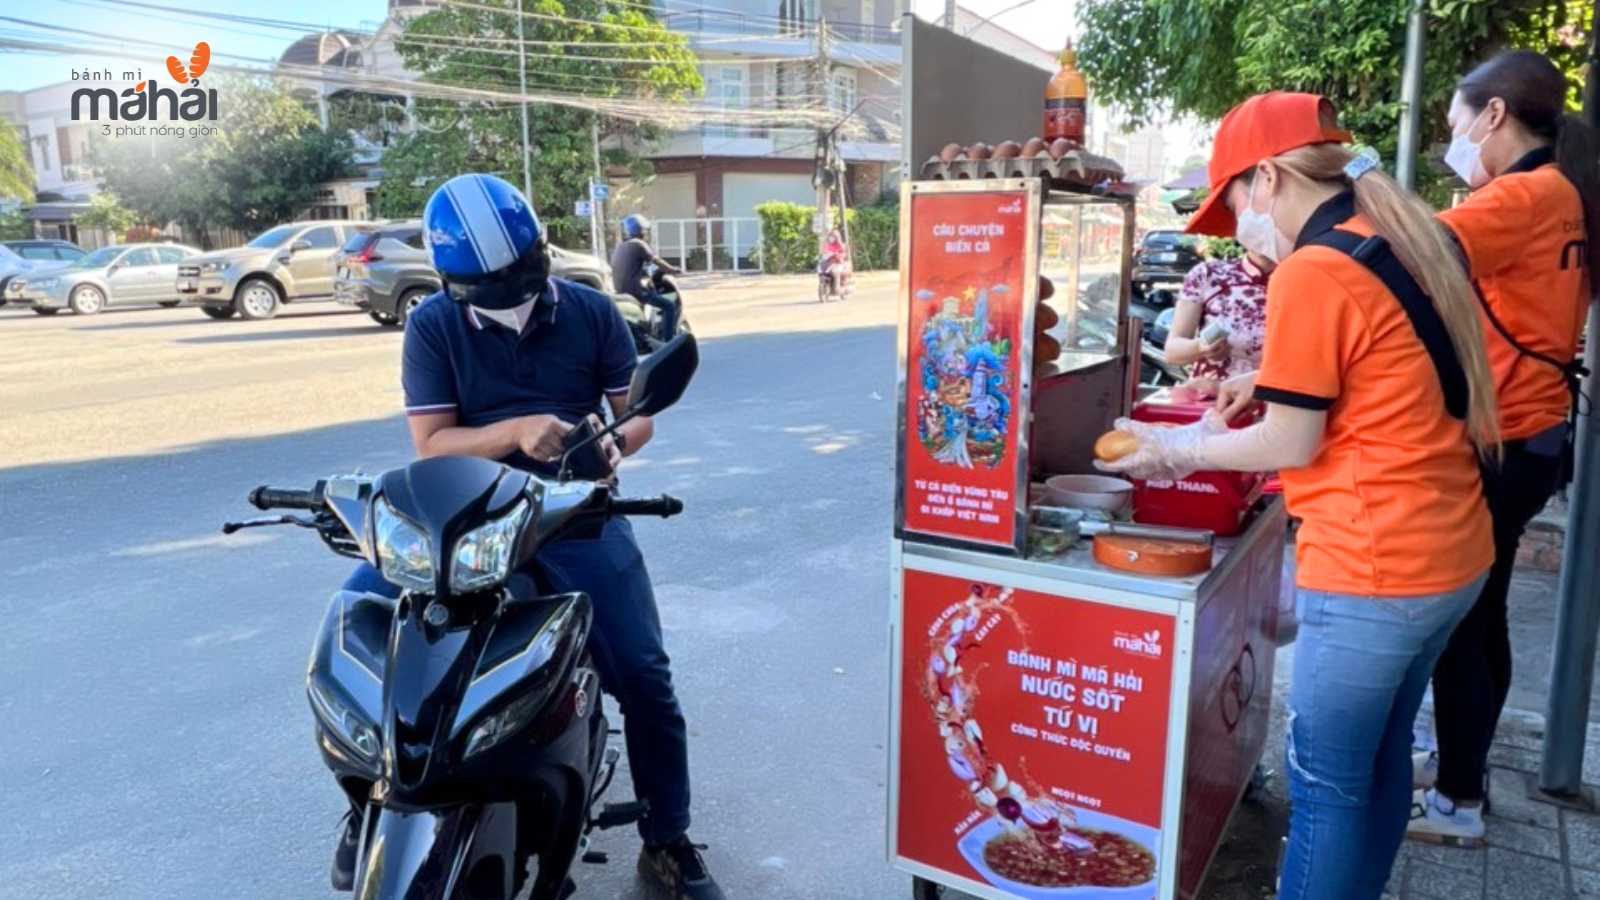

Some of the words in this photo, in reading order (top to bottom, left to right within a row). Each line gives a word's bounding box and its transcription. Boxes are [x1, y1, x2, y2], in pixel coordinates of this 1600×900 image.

[1007, 649, 1051, 671] BÁNH
[1056, 656, 1078, 678] MÌ
[1081, 664, 1109, 685] MÁ
[1113, 667, 1143, 692] HẢI
[1021, 674, 1076, 702] NƯỚC
[1081, 689, 1126, 713] SỐT
[1043, 704, 1074, 729] TỨ
[1076, 713, 1099, 738] VỊ
